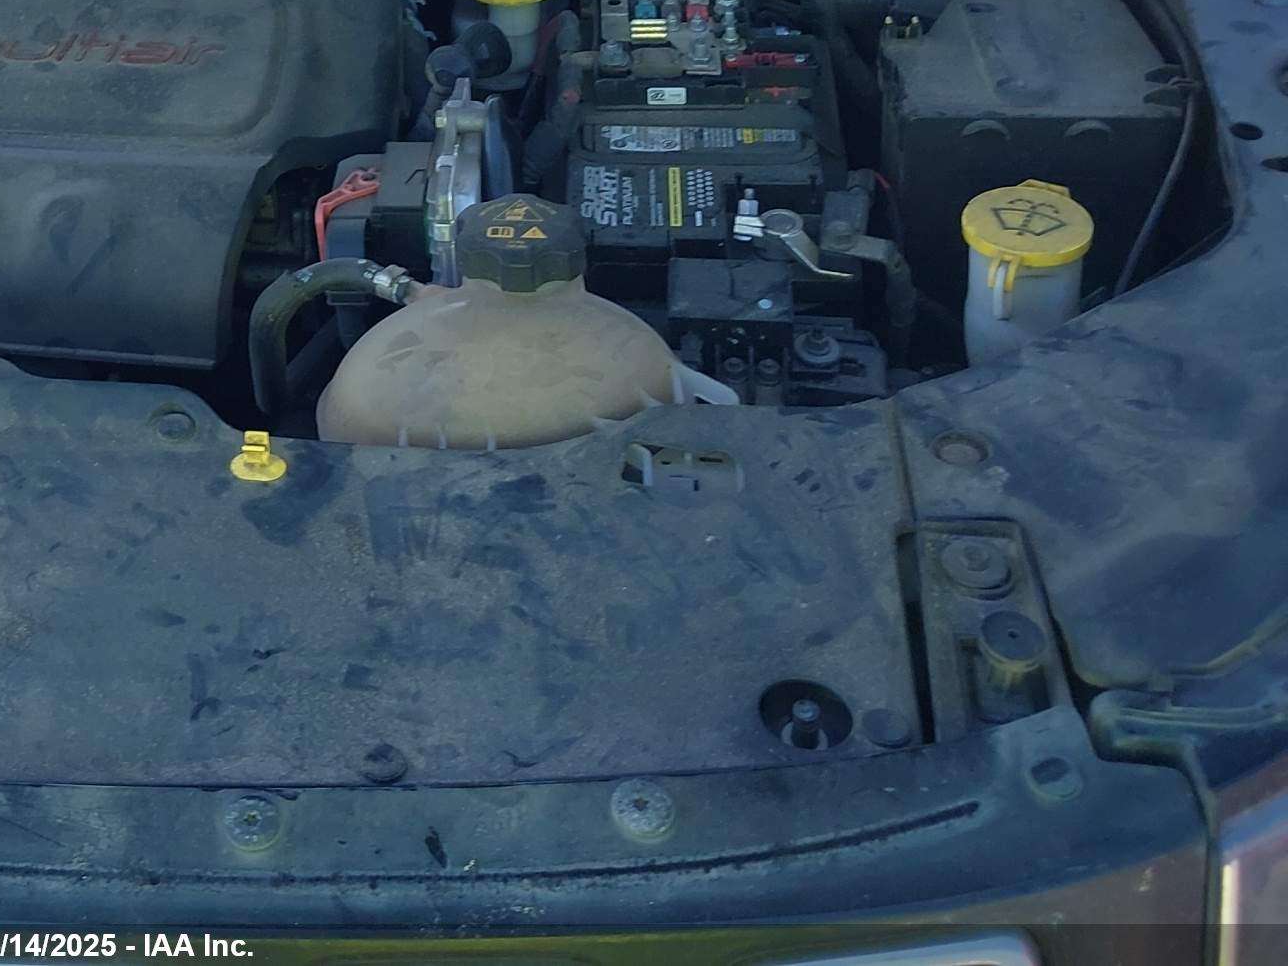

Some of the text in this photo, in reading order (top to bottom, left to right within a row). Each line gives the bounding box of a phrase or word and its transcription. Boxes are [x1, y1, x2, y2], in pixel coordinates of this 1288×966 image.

[580, 165, 604, 218] SUPER
[598, 166, 619, 227] START
[621, 176, 633, 226] PLATINUM
